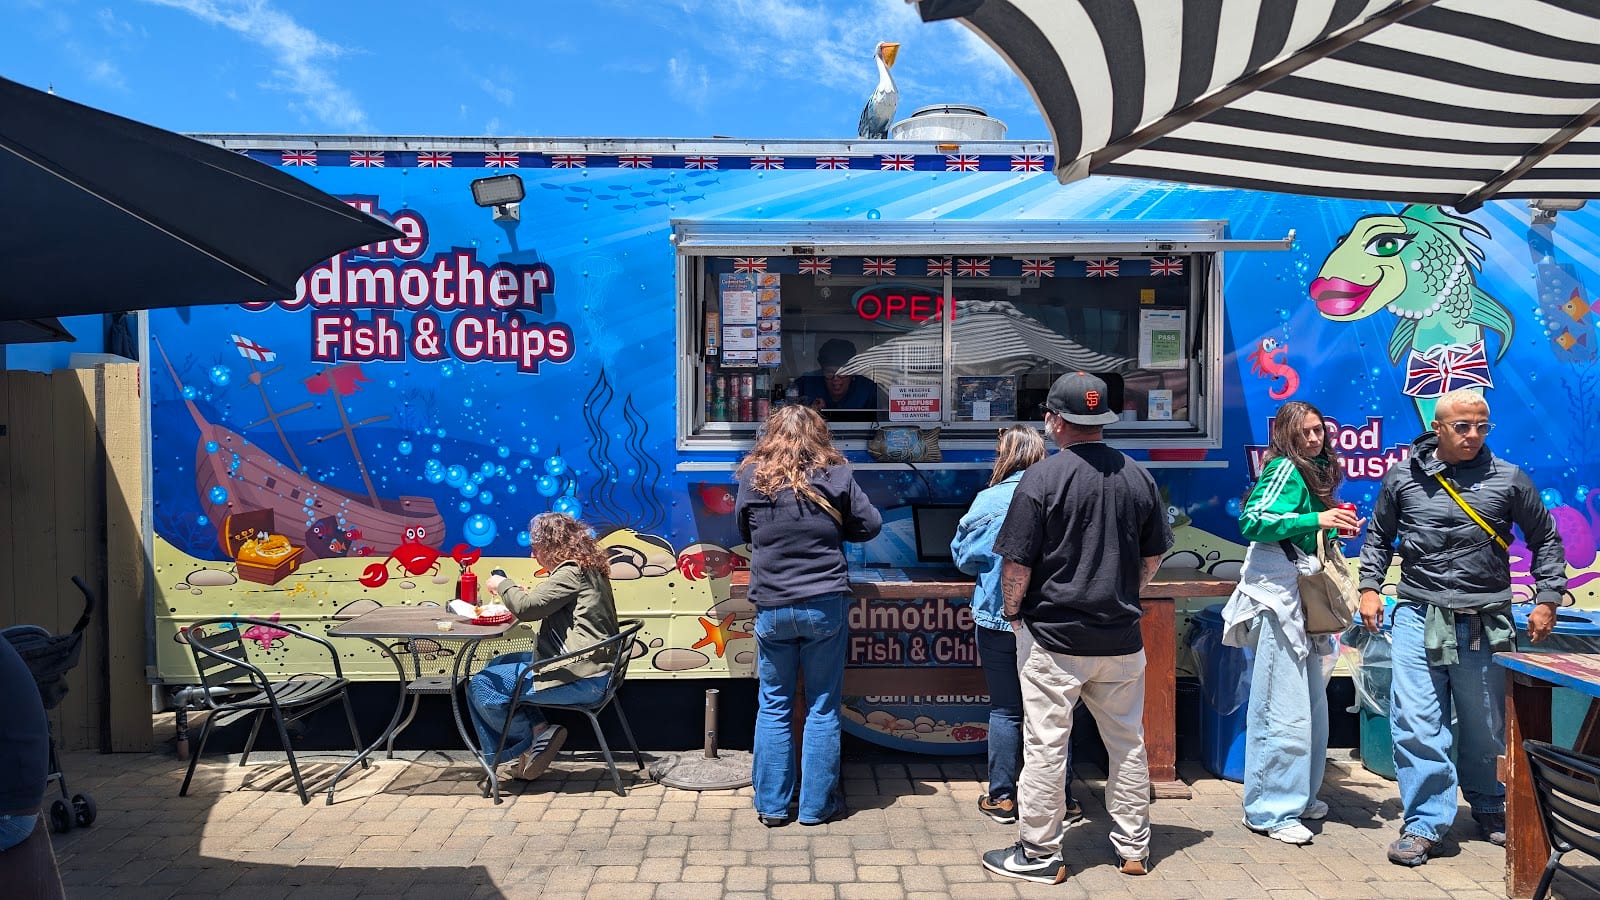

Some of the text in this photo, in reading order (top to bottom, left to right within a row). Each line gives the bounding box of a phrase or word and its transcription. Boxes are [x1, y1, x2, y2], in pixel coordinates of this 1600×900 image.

[247, 254, 548, 307] dmother
[857, 294, 957, 321] OPEN
[317, 317, 568, 367] Fish & Chips
[1337, 449, 1408, 478] rust
[848, 598, 975, 630] dmothe
[851, 636, 982, 667] Fish & Chi
[913, 695, 991, 703] rancis
